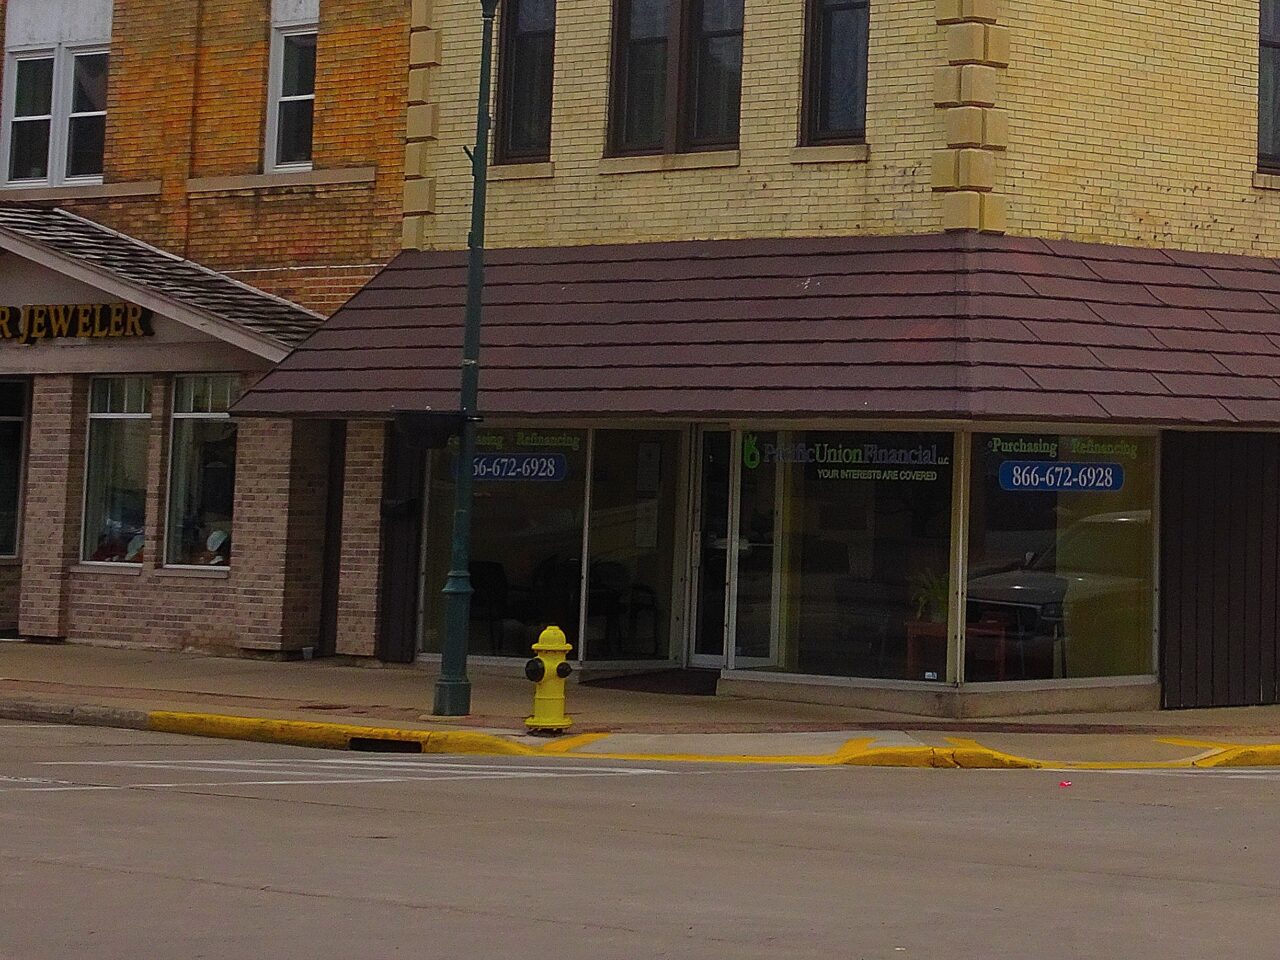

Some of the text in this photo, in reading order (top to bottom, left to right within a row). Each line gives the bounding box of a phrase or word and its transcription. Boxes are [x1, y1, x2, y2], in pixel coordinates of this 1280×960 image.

[18, 302, 144, 344] JEWELER
[991, 437, 1137, 459] Purchasing Refinancing
[473, 457, 555, 477] 66-672-6928
[817, 468, 937, 481] YOUR INTERESTS ARE COVERED
[1012, 465, 1113, 488] 866-672-6928
